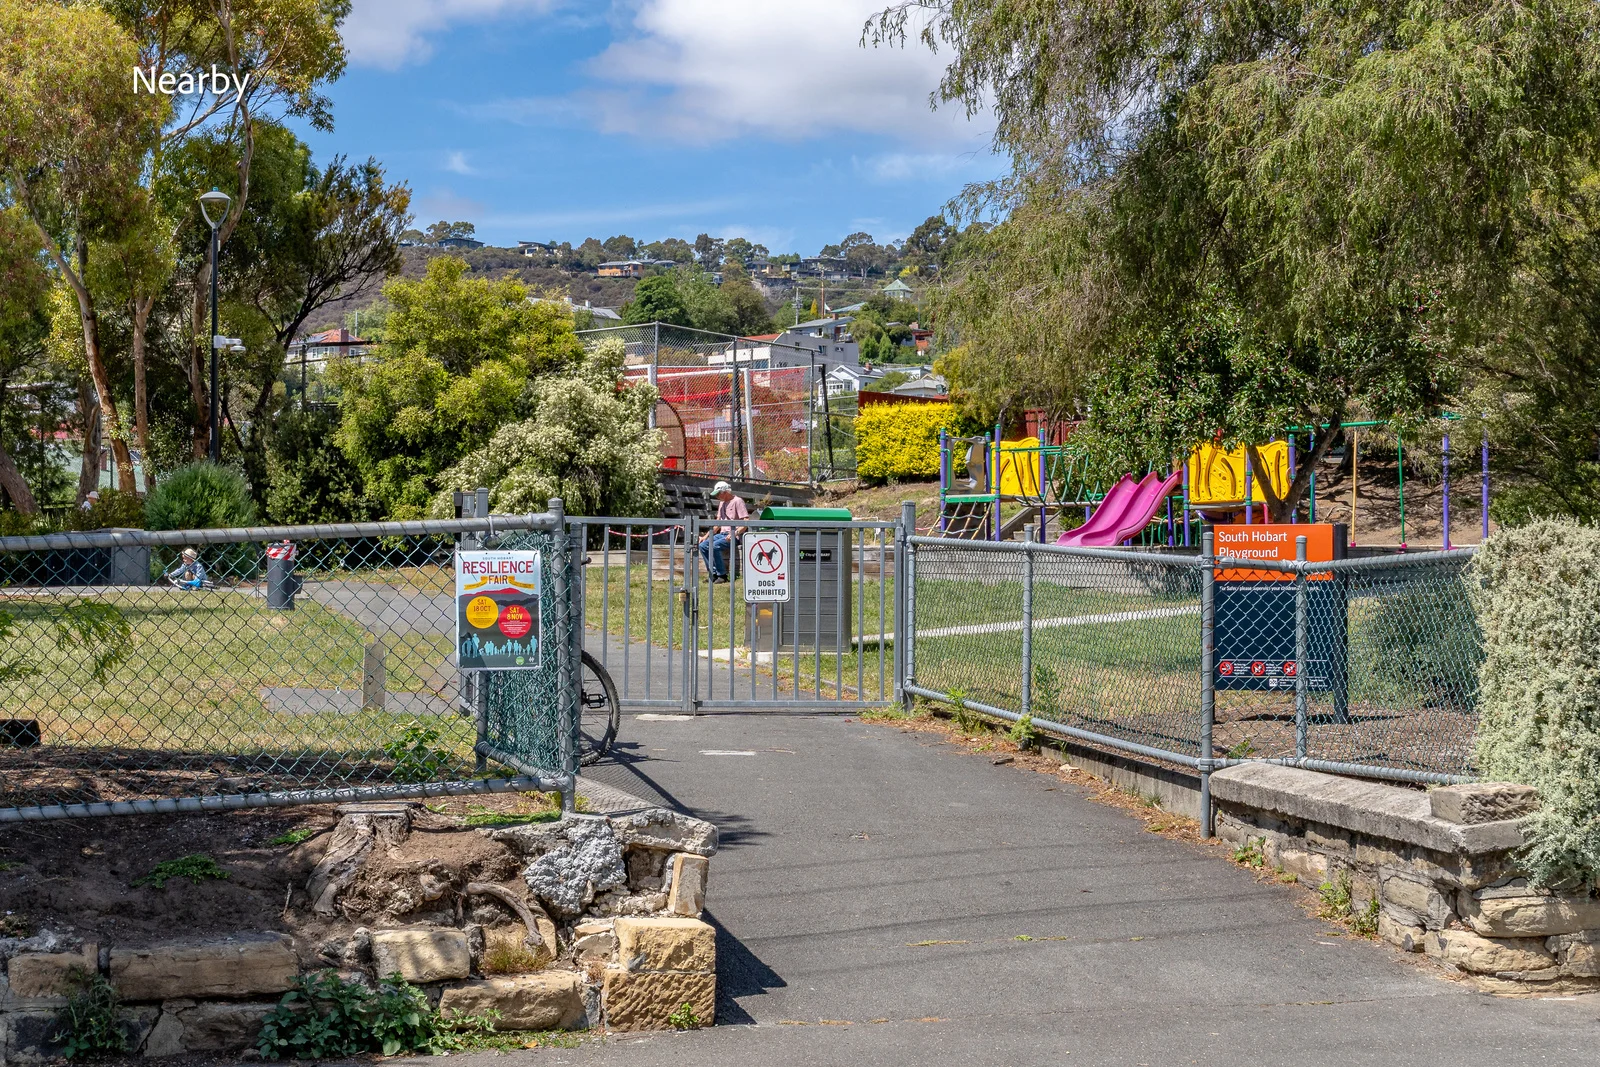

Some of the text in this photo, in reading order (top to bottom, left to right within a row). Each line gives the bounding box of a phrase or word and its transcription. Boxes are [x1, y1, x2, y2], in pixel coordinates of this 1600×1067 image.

[1218, 531, 1288, 542] South Hobart
[1219, 546, 1279, 560] Playground
[462, 560, 534, 574] RESILIENCE
[489, 575, 508, 584] FAIR
